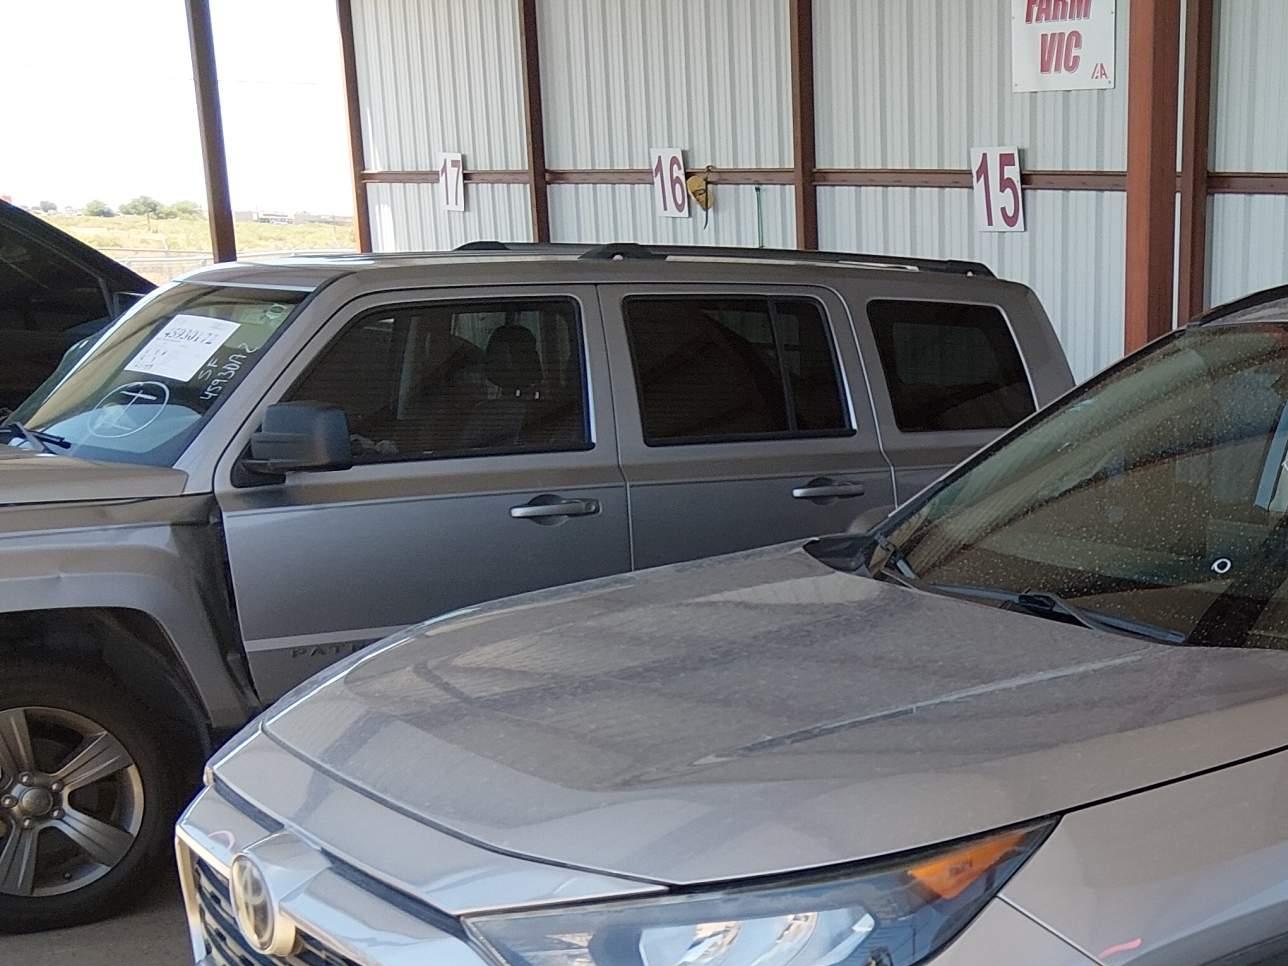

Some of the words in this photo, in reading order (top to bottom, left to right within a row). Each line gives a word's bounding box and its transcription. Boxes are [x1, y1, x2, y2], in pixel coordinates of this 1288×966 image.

[1040, 30, 1082, 74] VIC
[440, 159, 461, 206] 17
[654, 155, 686, 213] 16
[976, 153, 1020, 227] 15
